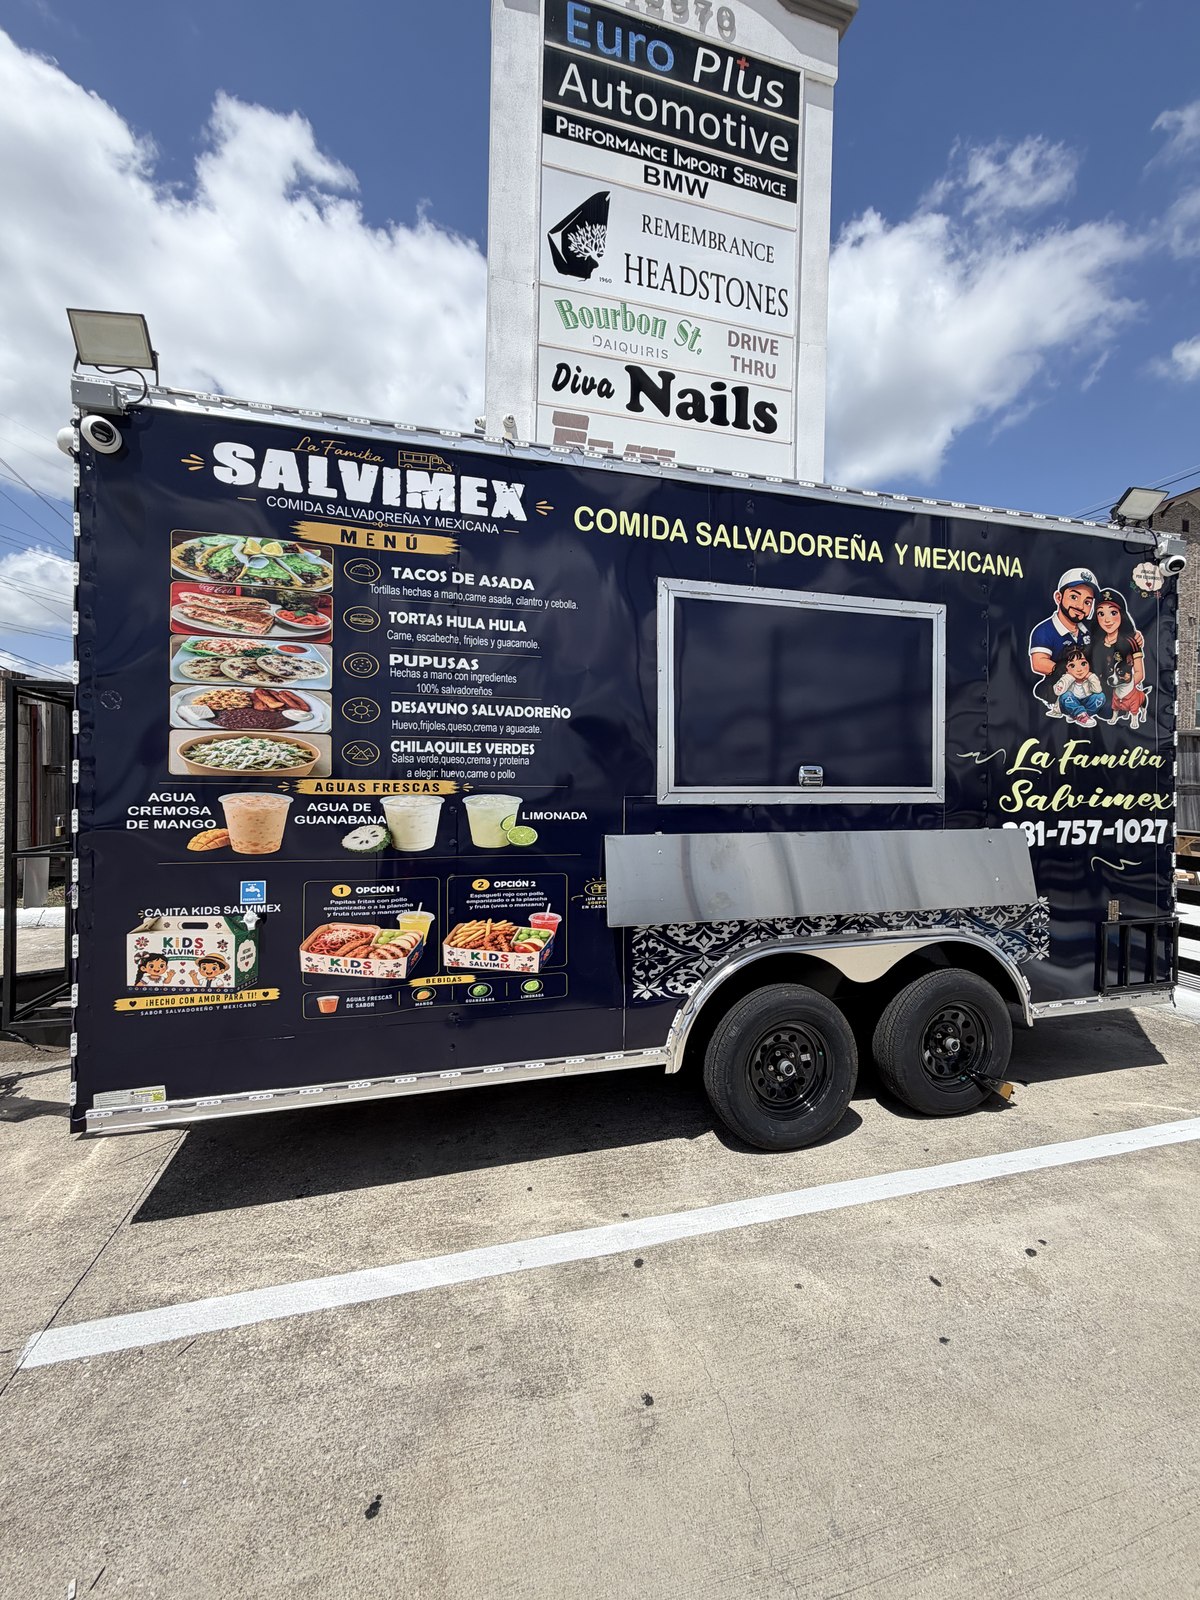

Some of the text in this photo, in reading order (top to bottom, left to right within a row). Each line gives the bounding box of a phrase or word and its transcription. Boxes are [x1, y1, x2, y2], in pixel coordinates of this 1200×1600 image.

[567, 0, 785, 109] Euro Plus
[558, 63, 789, 162] Automotive
[556, 115, 786, 197] PERFORMANCE IMPORT SERVICE
[644, 165, 709, 199] BMW
[641, 214, 775, 263] REMEMBRANCE
[599, 276, 613, 284] 1960
[624, 253, 789, 318] HEADSTONES
[554, 299, 702, 355] Bourbon St.
[593, 335, 668, 360] DAIQUIRIS
[728, 329, 779, 357] DRIVE
[730, 354, 777, 379] THRU
[551, 362, 778, 434] Diva Nails
[291, 436, 384, 463] La Familia
[212, 441, 528, 521] SALVIMEX
[266, 495, 499, 534] COMIDA SALVADOREÑA Y MEXICANA
[340, 528, 418, 551] MENÚ
[574, 505, 1024, 579] COMIDA SALVADOREÑA Y MEXICANA
[391, 567, 535, 591] TACOS DE ASADA
[370, 584, 400, 595] Tortillas
[402, 585, 432, 598] hechas
[433, 590, 439, 598] a
[488, 594, 515, 607] asada,
[516, 595, 543, 607] cilantro
[544, 600, 549, 610] y
[550, 599, 579, 610] cebolla.
[389, 611, 527, 633] TORTAS HULA HULA
[416, 632, 462, 645] escabeche,
[463, 635, 489, 647] frijoles
[490, 640, 496, 649] y
[497, 638, 540, 650] guacamole.
[389, 654, 479, 671] PUPUSAS
[390, 668, 517, 684] Hechas a mano con ingredientes
[416, 683, 493, 696] 100% salvadoreños
[391, 701, 572, 719] DESAYUNO SALVADOREÑO
[499, 725, 505, 735] y
[505, 724, 543, 736] aguacate.
[390, 740, 535, 756] CHILAQUILES VERDES
[391, 753, 414, 764] Salsa
[493, 758, 498, 767] y
[1005, 738, 1165, 775] La Familia
[414, 769, 439, 781] elegir:
[497, 769, 516, 781] pollo
[314, 781, 440, 793] AGUAS FRESCAS
[148, 792, 196, 803] AGUA
[1000, 779, 1174, 813] Salvimex
[127, 806, 212, 816] CREMOSA
[307, 802, 371, 812] AGUA DE
[294, 815, 387, 825] GUANABANA
[522, 811, 588, 820] LIMONADA
[126, 819, 216, 830] DE MANGO
[493, 879, 529, 888] OPCIÓN
[144, 904, 281, 917] CAJITA KIDS SALVIMEX
[331, 957, 372, 969] KIDS
[469, 961, 511, 969] SALVIMEX
[471, 951, 509, 963] KIDS
[328, 966, 374, 976] SALVIMEX
[426, 976, 462, 984] BEBIDAS
[145, 998, 176, 1007] ¡HECHO
[179, 996, 195, 1005] CON
[198, 995, 221, 1003] AMOR
[224, 993, 244, 1001] PARA
[367, 994, 393, 1002] FRESCAS
[165, 1006, 213, 1015] SALVADOREÑO
